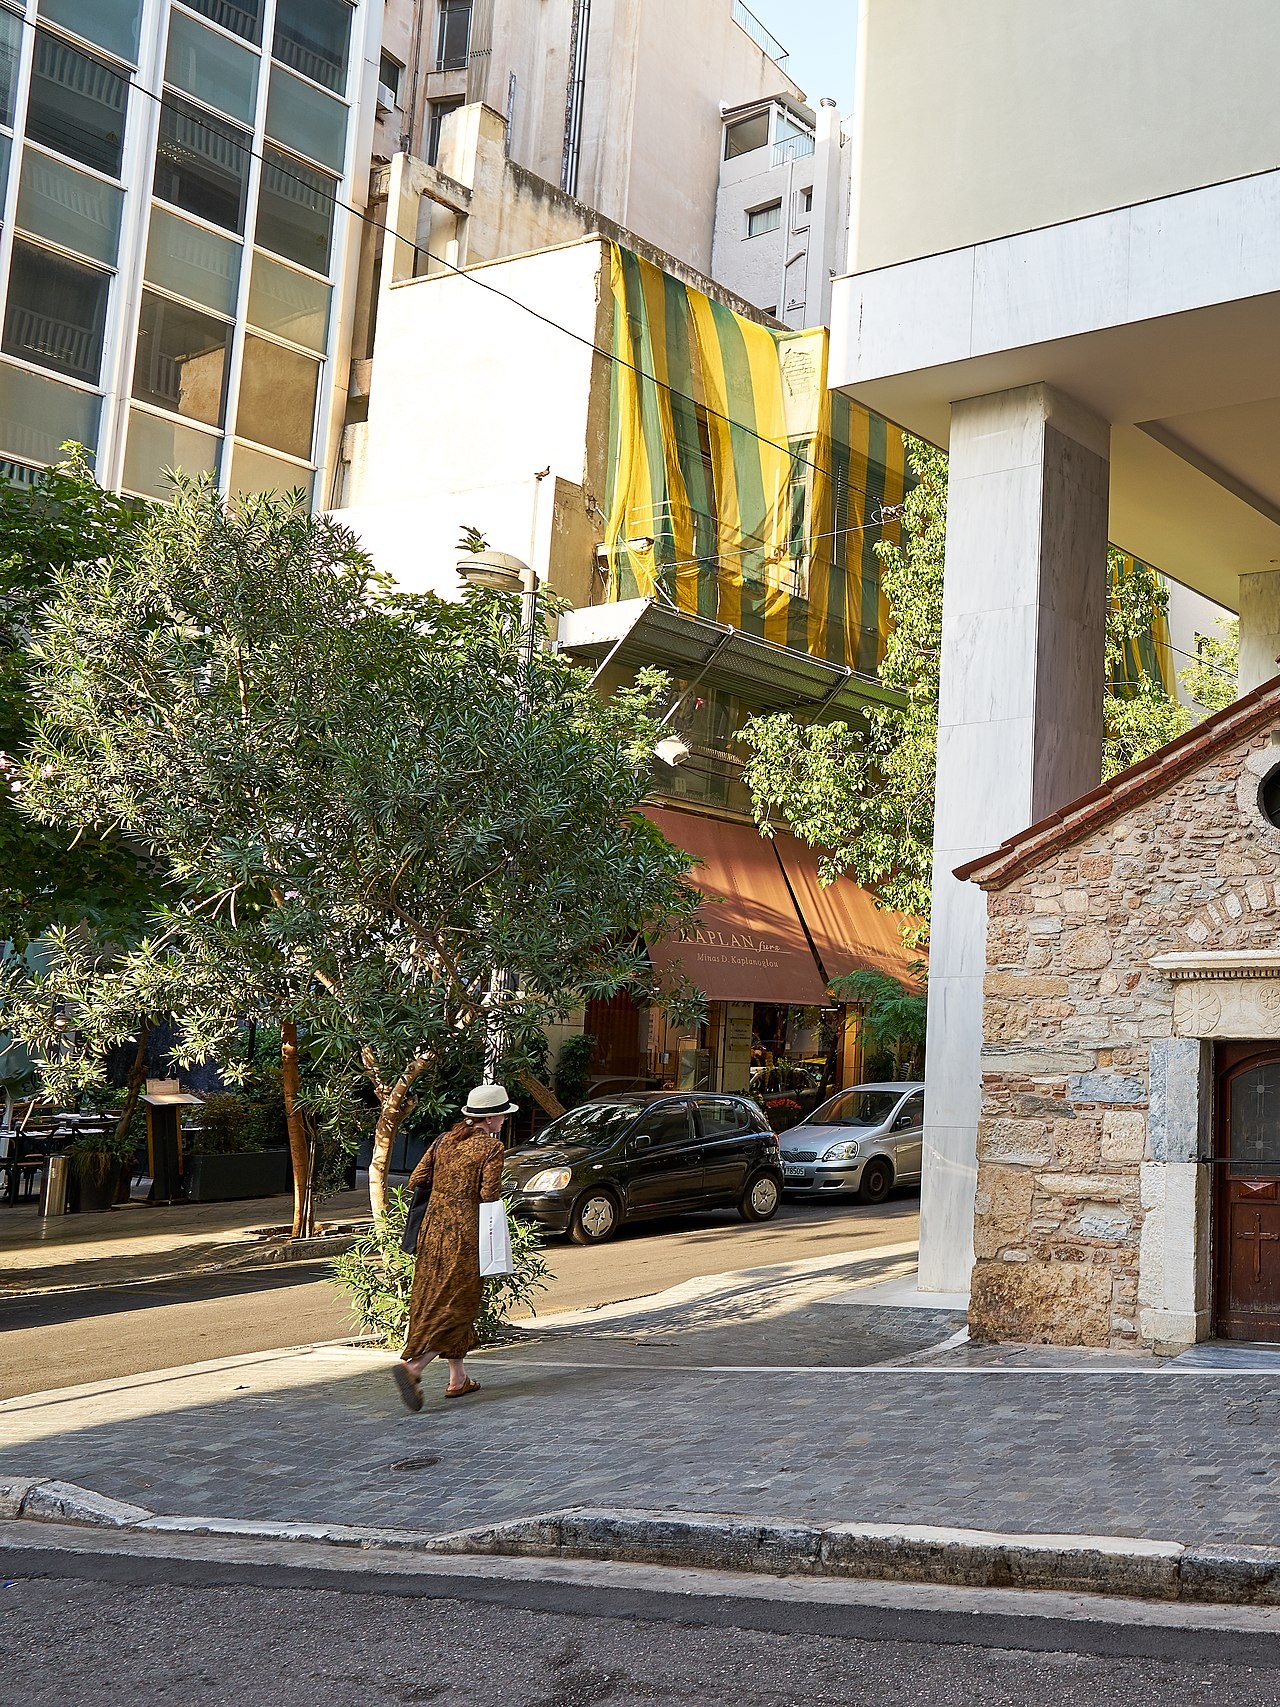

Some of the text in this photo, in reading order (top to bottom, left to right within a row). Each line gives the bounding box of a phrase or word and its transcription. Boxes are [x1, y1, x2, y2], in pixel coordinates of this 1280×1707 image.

[679, 928, 754, 949] KAPLAN
[697, 952, 779, 969] Minas D. Kaplanoglou
